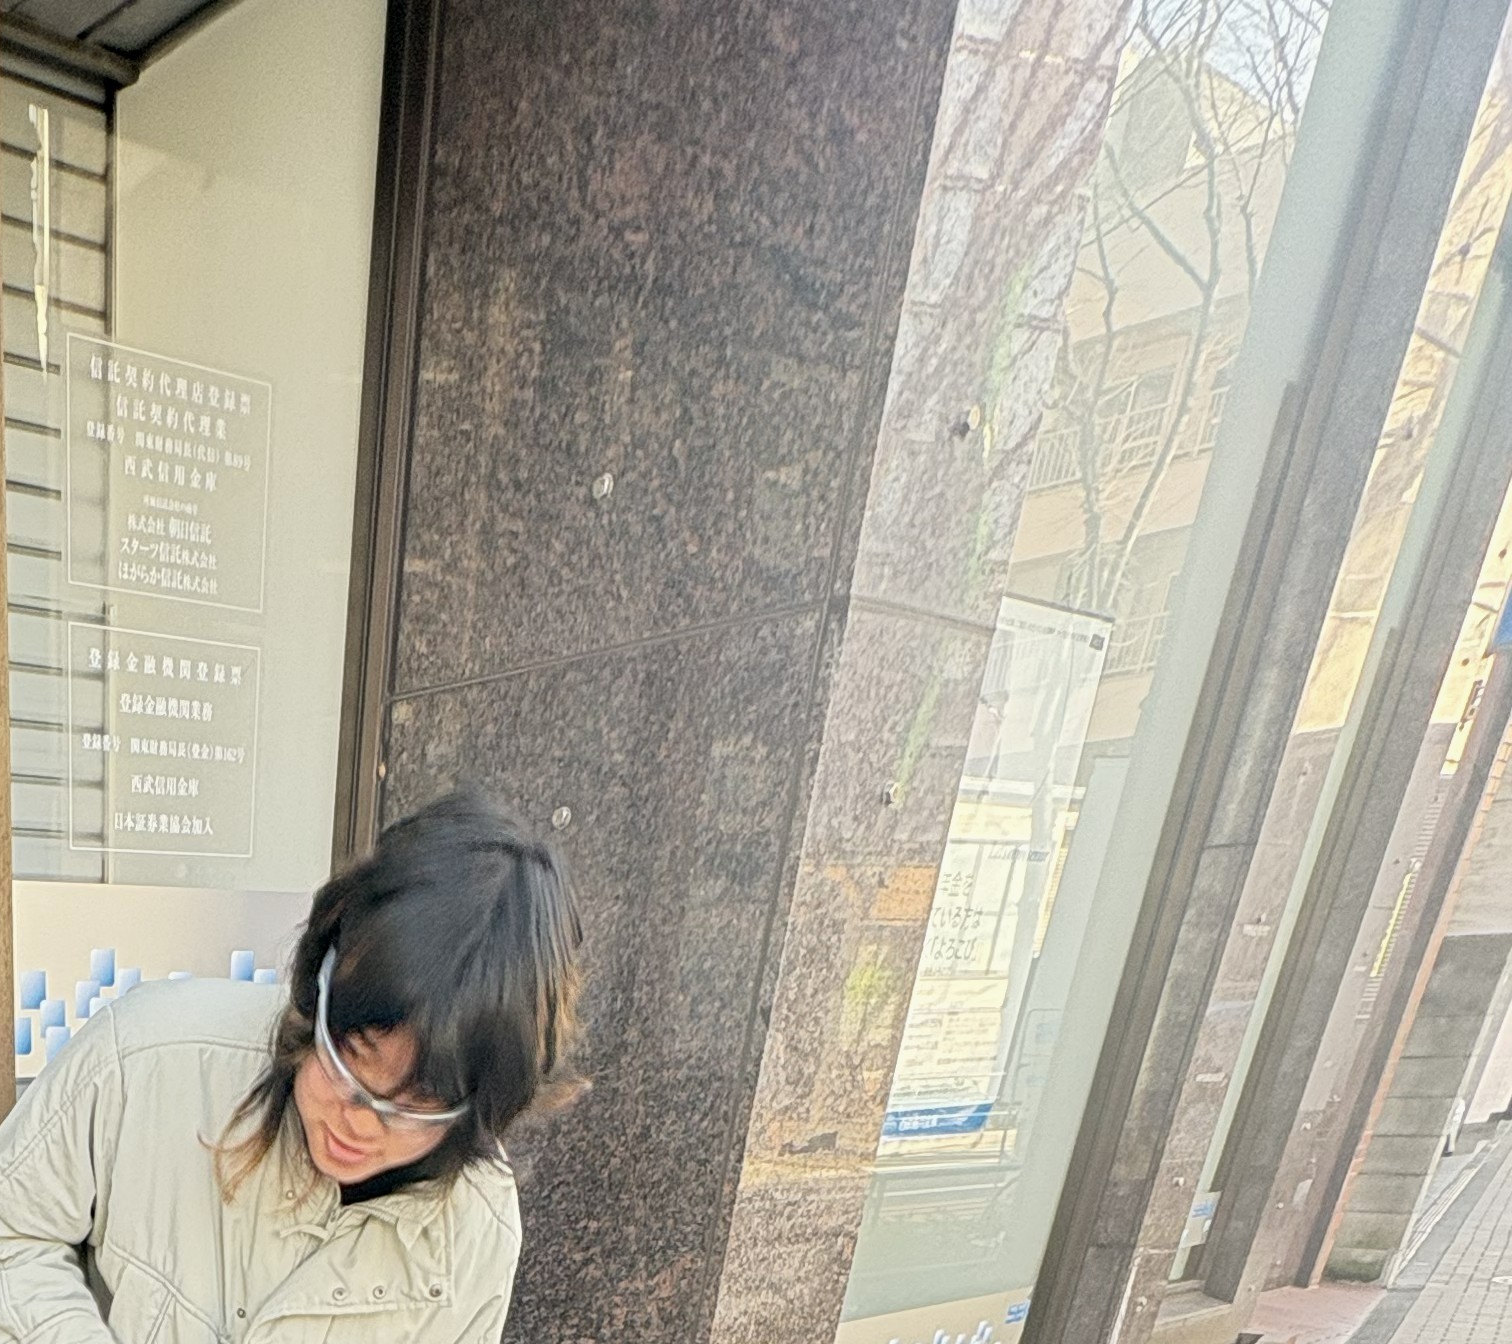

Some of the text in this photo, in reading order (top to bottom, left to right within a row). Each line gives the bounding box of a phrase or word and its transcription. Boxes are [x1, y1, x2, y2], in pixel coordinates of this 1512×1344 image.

[124, 454, 218, 493] 西武信用金庫
[130, 774, 200, 798] 西武信用金庫
